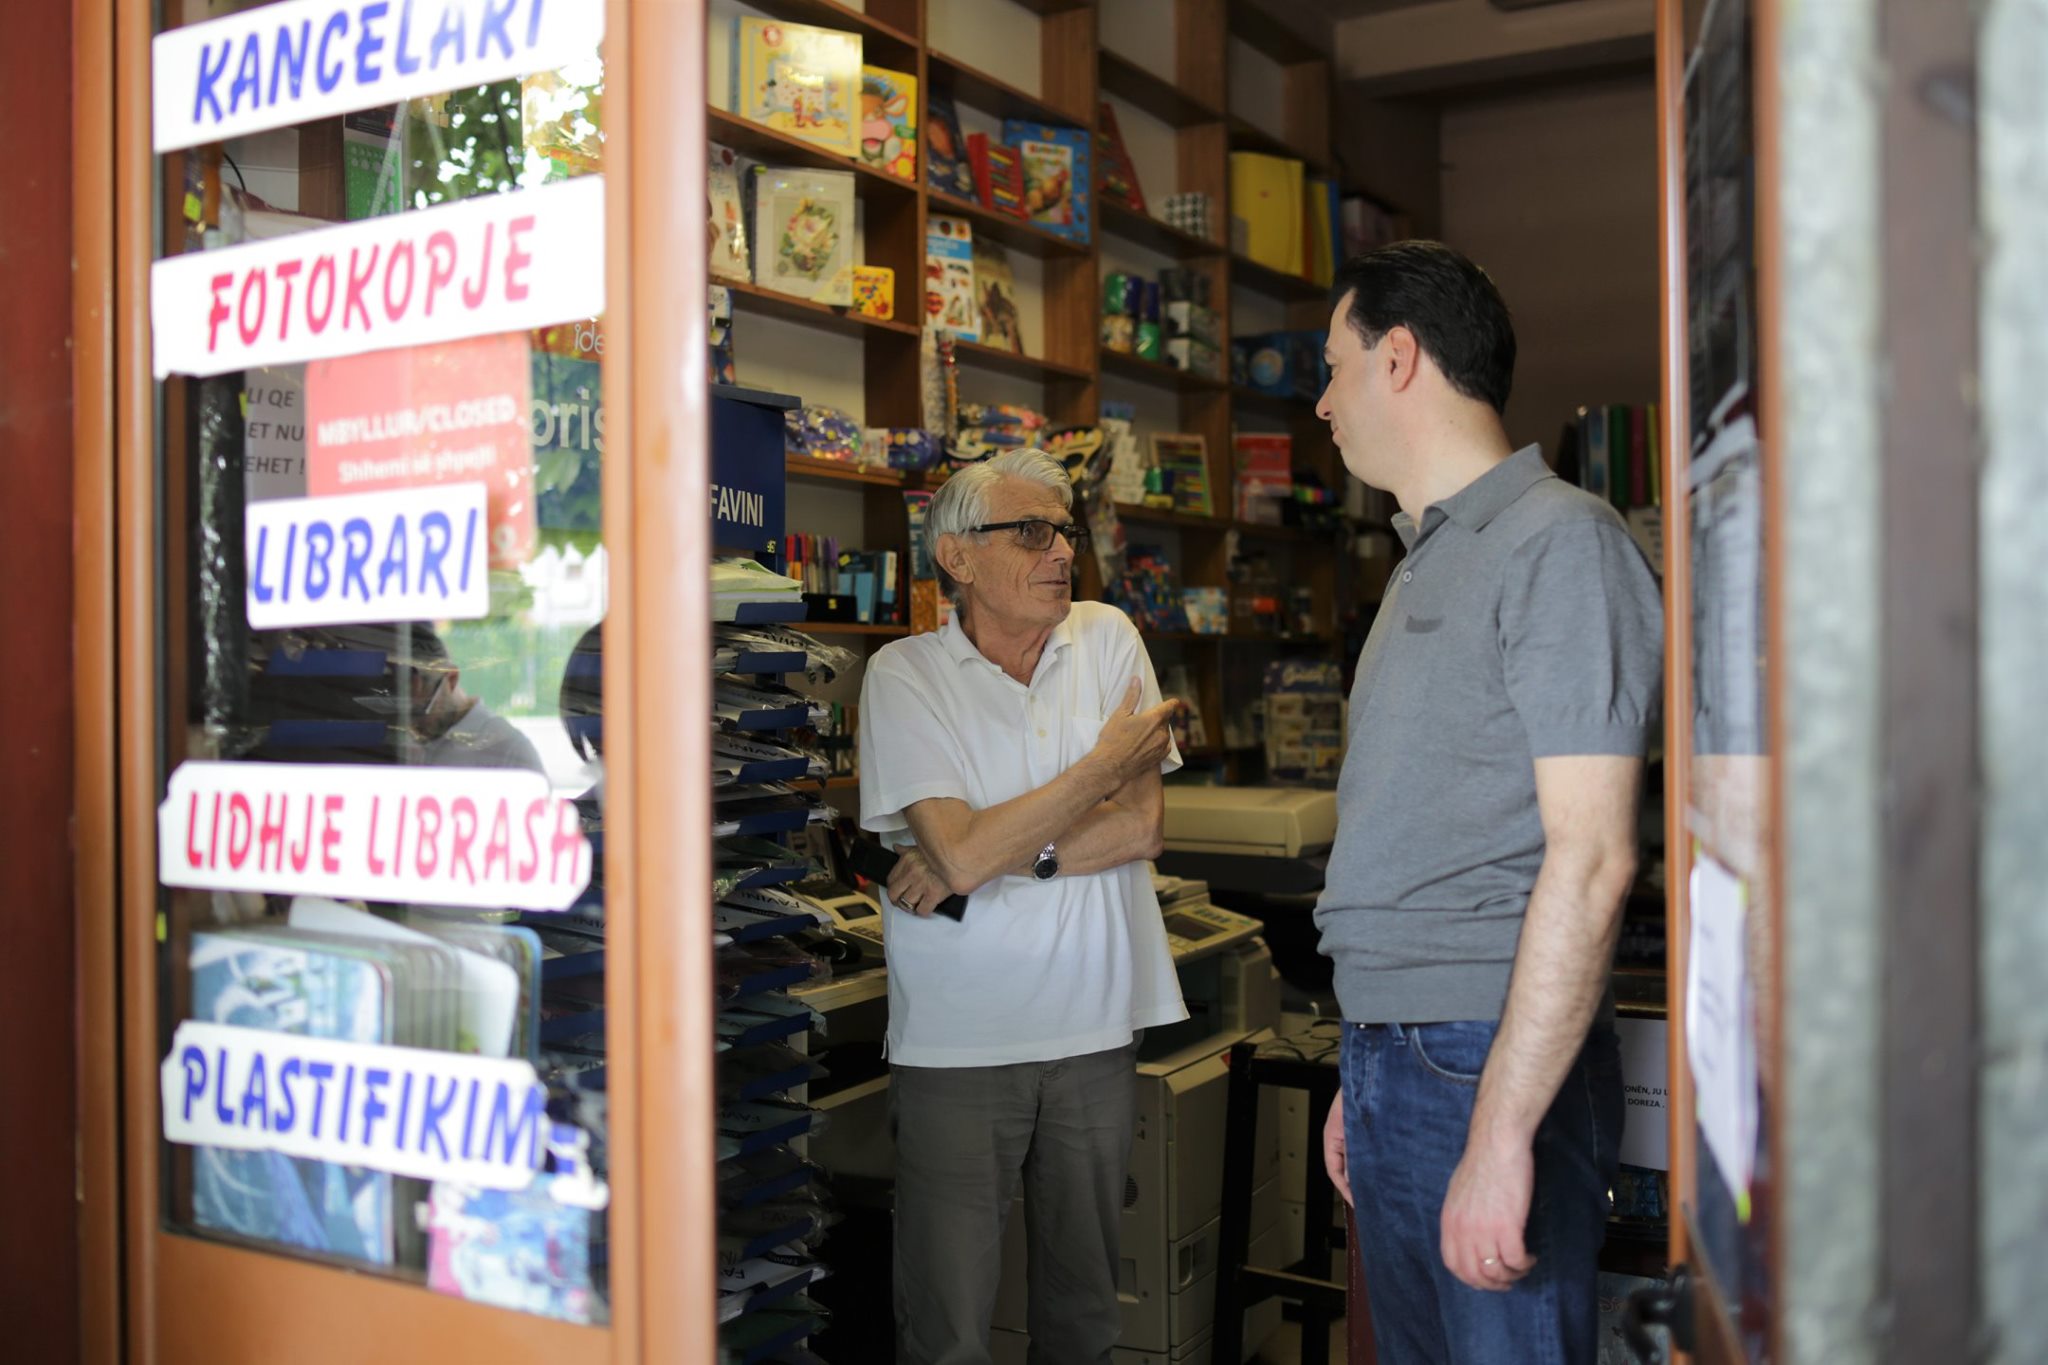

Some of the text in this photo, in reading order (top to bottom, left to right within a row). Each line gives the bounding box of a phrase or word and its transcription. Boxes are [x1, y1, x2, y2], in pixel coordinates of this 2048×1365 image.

[193, 0, 543, 124] KANCELARI
[207, 214, 536, 354] FOTOKOPJE
[267, 388, 296, 409] QE
[708, 483, 764, 528] FAVINI
[252, 507, 479, 604] LIBRARI
[185, 790, 586, 887] LIDHJE LIBRASH
[1627, 1097, 1661, 1108] DOREZA
